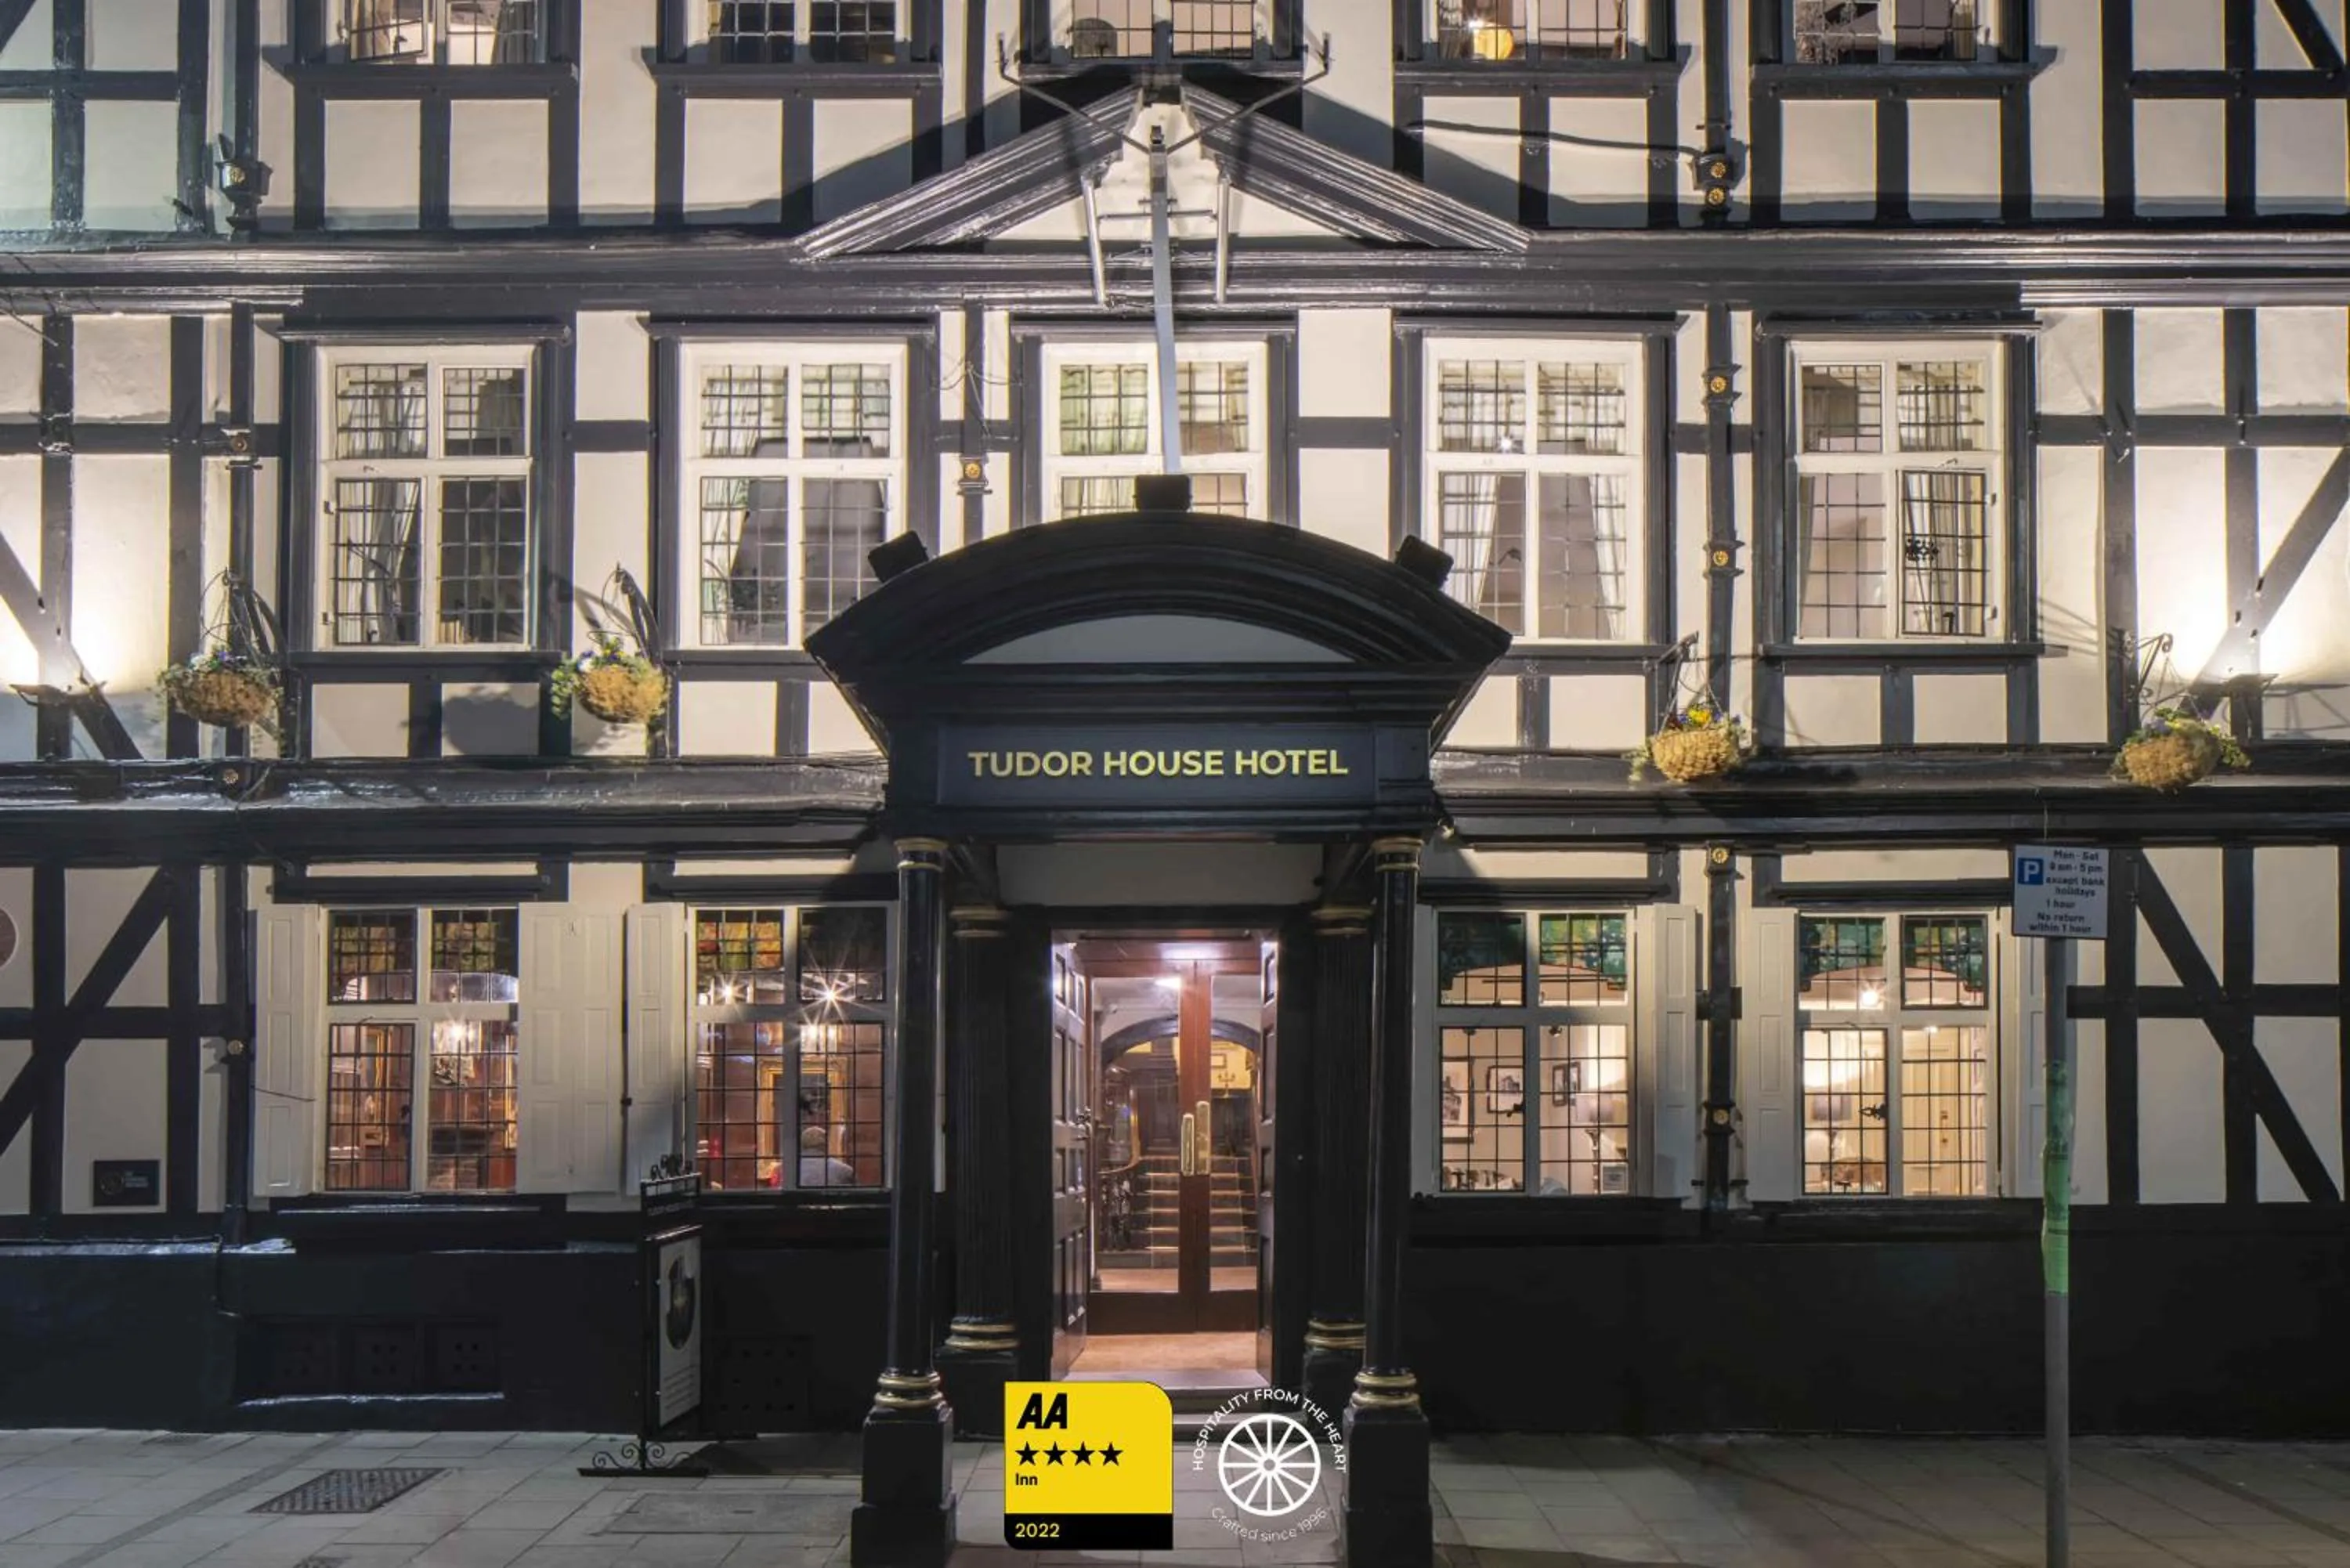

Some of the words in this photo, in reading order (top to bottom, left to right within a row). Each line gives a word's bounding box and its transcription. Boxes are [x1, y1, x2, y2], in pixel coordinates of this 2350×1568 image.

[968, 750, 1092, 778] TUDOR
[1104, 750, 1224, 776] HOUSE
[1235, 749, 1349, 775] HOTEL
[2054, 850, 2074, 860] Mon
[2082, 851, 2099, 861] Sat
[2023, 861, 2039, 883] P
[2088, 865, 2104, 874] pm
[2046, 876, 2078, 886] except
[2081, 876, 2105, 886] bank
[2055, 886, 2095, 898] holidays
[2053, 898, 2076, 909] hour
[2037, 912, 2051, 921] No
[2054, 913, 2084, 923] return
[2029, 922, 2060, 932] within
[2069, 924, 2092, 934] hour
